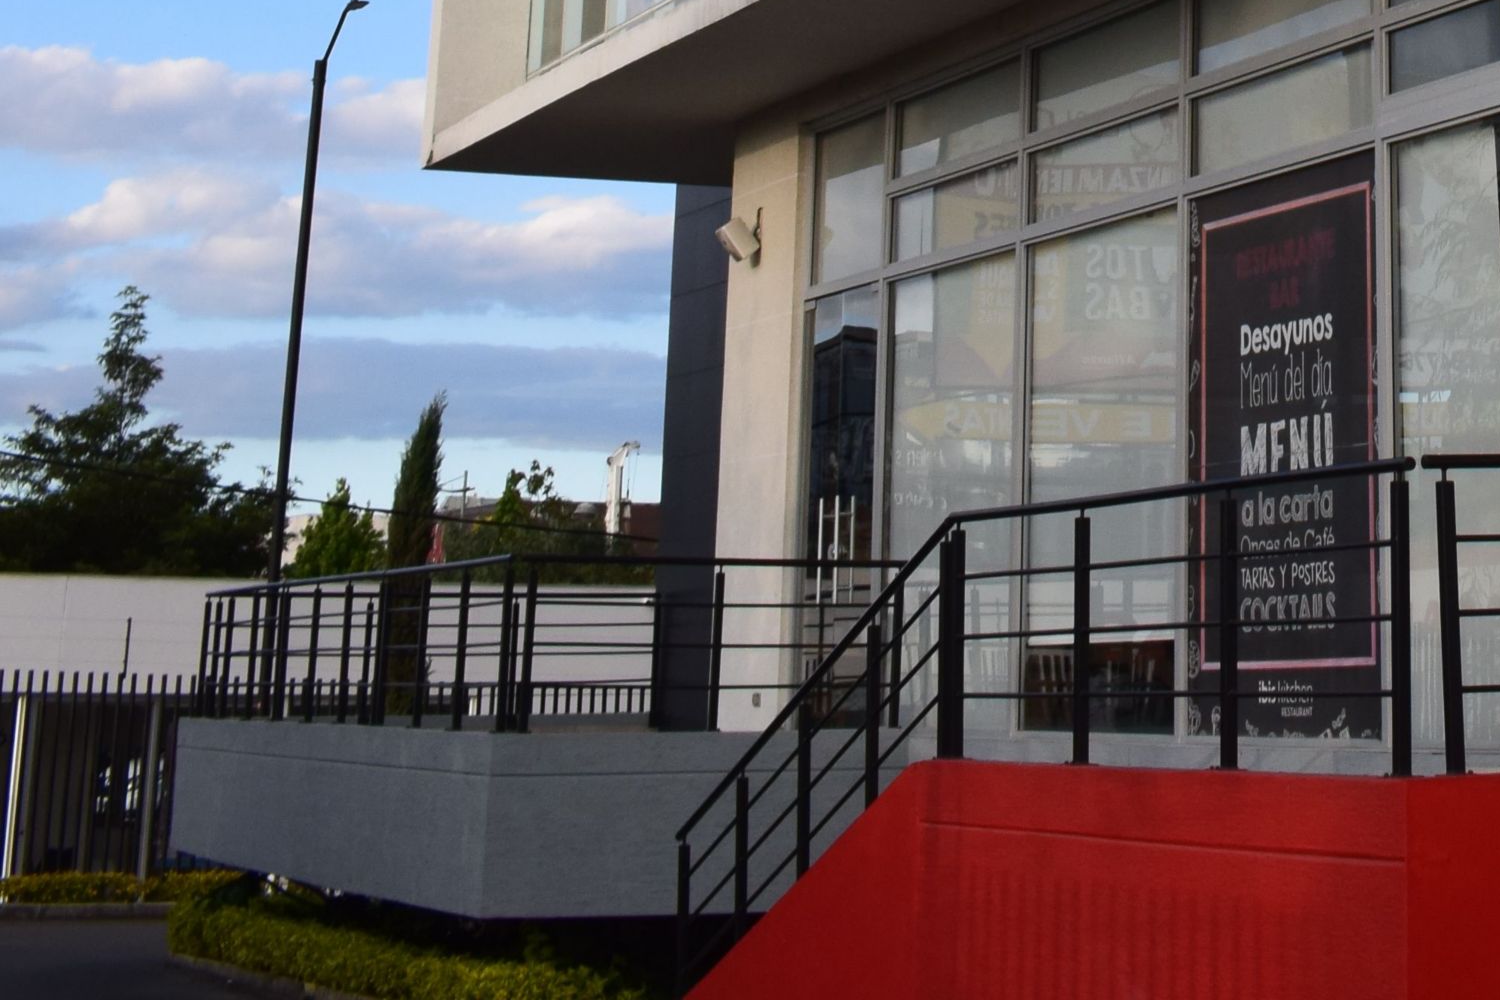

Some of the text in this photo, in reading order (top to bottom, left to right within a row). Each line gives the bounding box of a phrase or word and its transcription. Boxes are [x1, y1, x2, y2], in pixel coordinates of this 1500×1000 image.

[1240, 313, 1333, 356] Desayunos
[1240, 348, 1333, 409] Menú del día
[1240, 399, 1334, 477] MENÚ
[1241, 484, 1334, 528] a la carta
[1283, 530, 1301, 559] de
[1303, 526, 1335, 552] Café
[1241, 561, 1336, 590] TARTAS Y POSTRES
[1240, 591, 1336, 632] COCKTAILS
[1258, 680, 1277, 704] ibis
